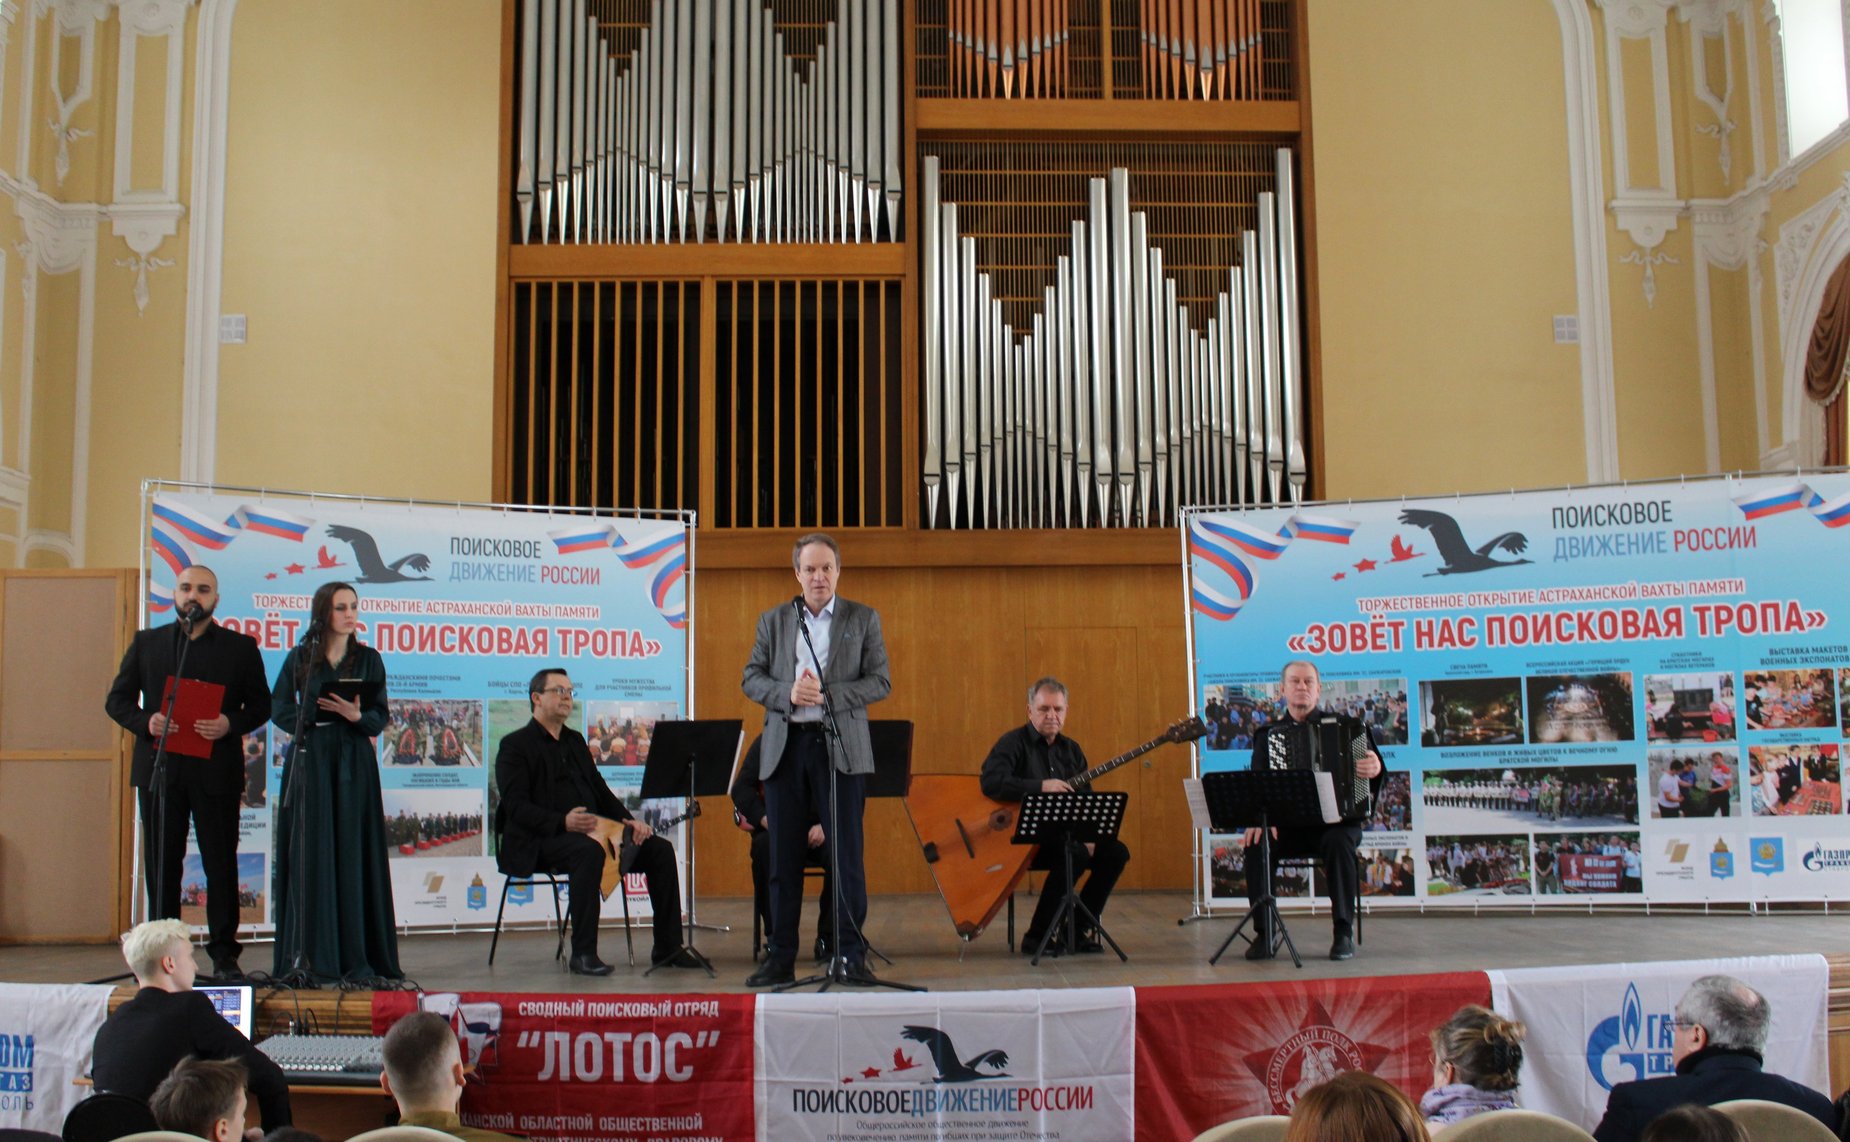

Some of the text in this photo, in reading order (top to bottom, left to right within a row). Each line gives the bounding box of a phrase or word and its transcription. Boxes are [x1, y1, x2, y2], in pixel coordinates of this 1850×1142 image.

[1552, 500, 1673, 529] ПОИСКОВОЕ
[450, 537, 542, 559] ПОИСКОВОЕ
[1553, 526, 1757, 562] ДВИЖЕНИЕ РОССИИ
[450, 561, 600, 585] ДВИЖЕНИЕ РОССИИ
[254, 594, 599, 618] ТОРЖЕСТ ОТКРЫТИЕ АСТРАХАНСКОЙ ВАХТЫ ПАМЯТИ
[1358, 580, 1744, 612] ТОРЖЕСТВЕННОЕ ОТКРЫТИЕ АСТРАХАНСКОЙ ВАХТЫ ПАМЯТИ
[1288, 601, 1827, 654] «ЗОВЁТ НАС ПОИСКОВАЯ ТРОПА»
[377, 623, 549, 656] ПОИСКОВАЯ
[557, 629, 662, 658] ТРОПА»
[1769, 645, 1848, 656] ВЫСТАВКА МАКЕТОВ
[1760, 654, 1850, 666] ВОЕННЫХ ЭКСПОНАТОВ
[519, 999, 719, 1018] СВОДНЫЙ ПОИСКОВЫЙ ОТРЯД
[517, 1030, 720, 1083] "ЛОТОС"
[1269, 1027, 1319, 1104] БЕССМЕРТНЫЙ
[1322, 1029, 1350, 1052] ПОЛК
[461, 1112, 703, 1132] ХАНСКОЙ ОБЛАСТНОЙ ОБЩЕСТВЕННОЙ
[856, 1120, 1029, 1131] Общероссийское общественное движение
